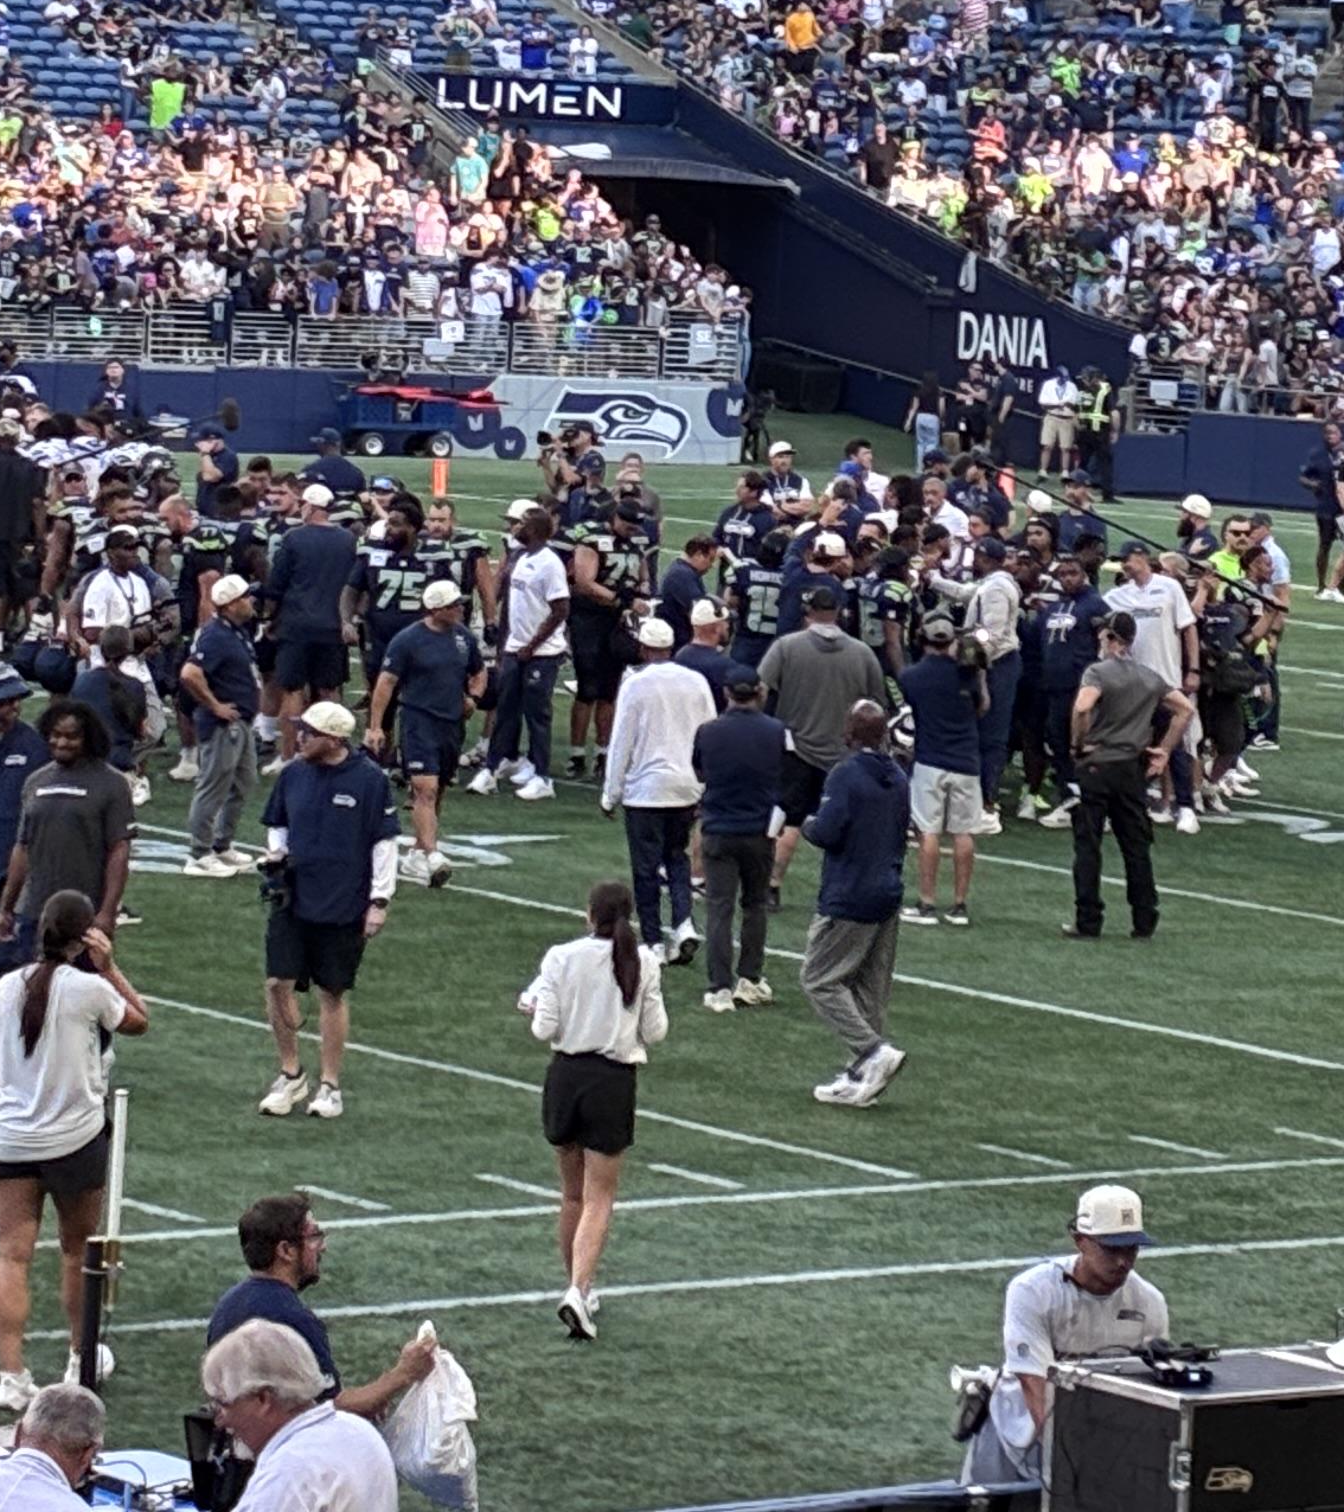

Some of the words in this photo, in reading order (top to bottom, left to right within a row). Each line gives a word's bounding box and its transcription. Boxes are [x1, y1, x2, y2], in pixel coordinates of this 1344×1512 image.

[437, 78, 622, 118] LUMEN
[958, 310, 1049, 369] DANIA
[377, 569, 427, 611] 75
